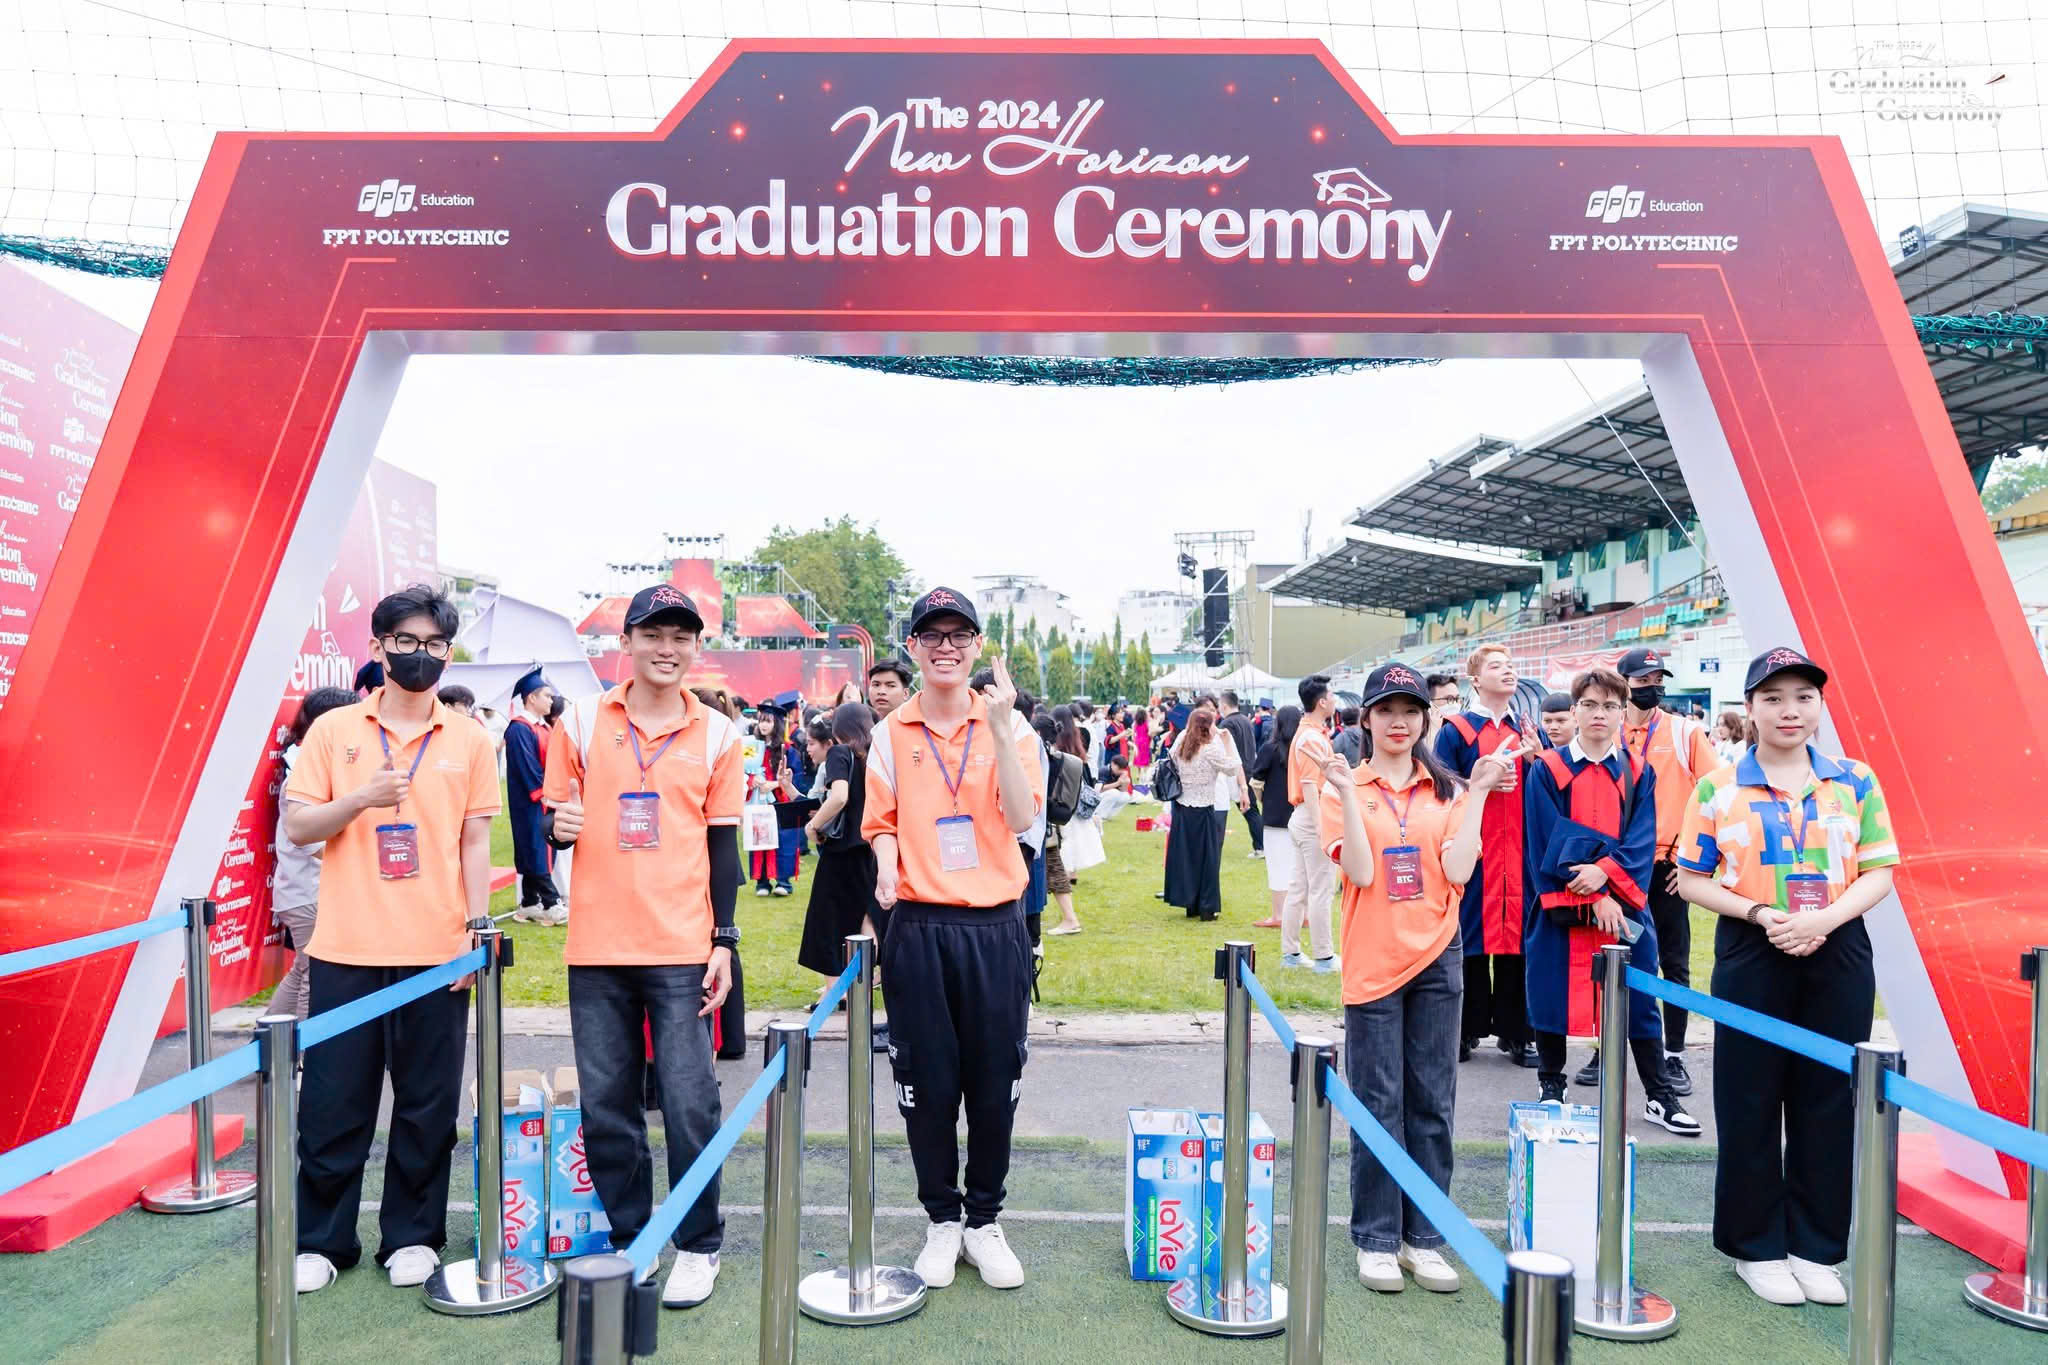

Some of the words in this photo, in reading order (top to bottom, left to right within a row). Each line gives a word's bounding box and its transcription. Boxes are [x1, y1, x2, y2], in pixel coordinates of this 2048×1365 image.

[906, 97, 969, 129] The
[978, 100, 1061, 130] 2024
[830, 106, 972, 174] New
[982, 98, 1250, 176] Horizon
[357, 179, 417, 217] FPT
[420, 194, 475, 207] Education
[1585, 185, 1645, 223] FPT
[1649, 200, 1704, 212] Education
[323, 229, 361, 246] FPT
[364, 229, 510, 246] POLYTECHNIC
[605, 179, 1029, 259] Graduation
[1053, 185, 1453, 283] Ceremony
[1549, 235, 1588, 251] FPT
[1591, 235, 1739, 252] POLYTECHNIC
[630, 822, 649, 831] BTC
[389, 853, 408, 862] BTC
[1396, 875, 1414, 884] BTC
[1159, 1200, 1185, 1271] laVie
